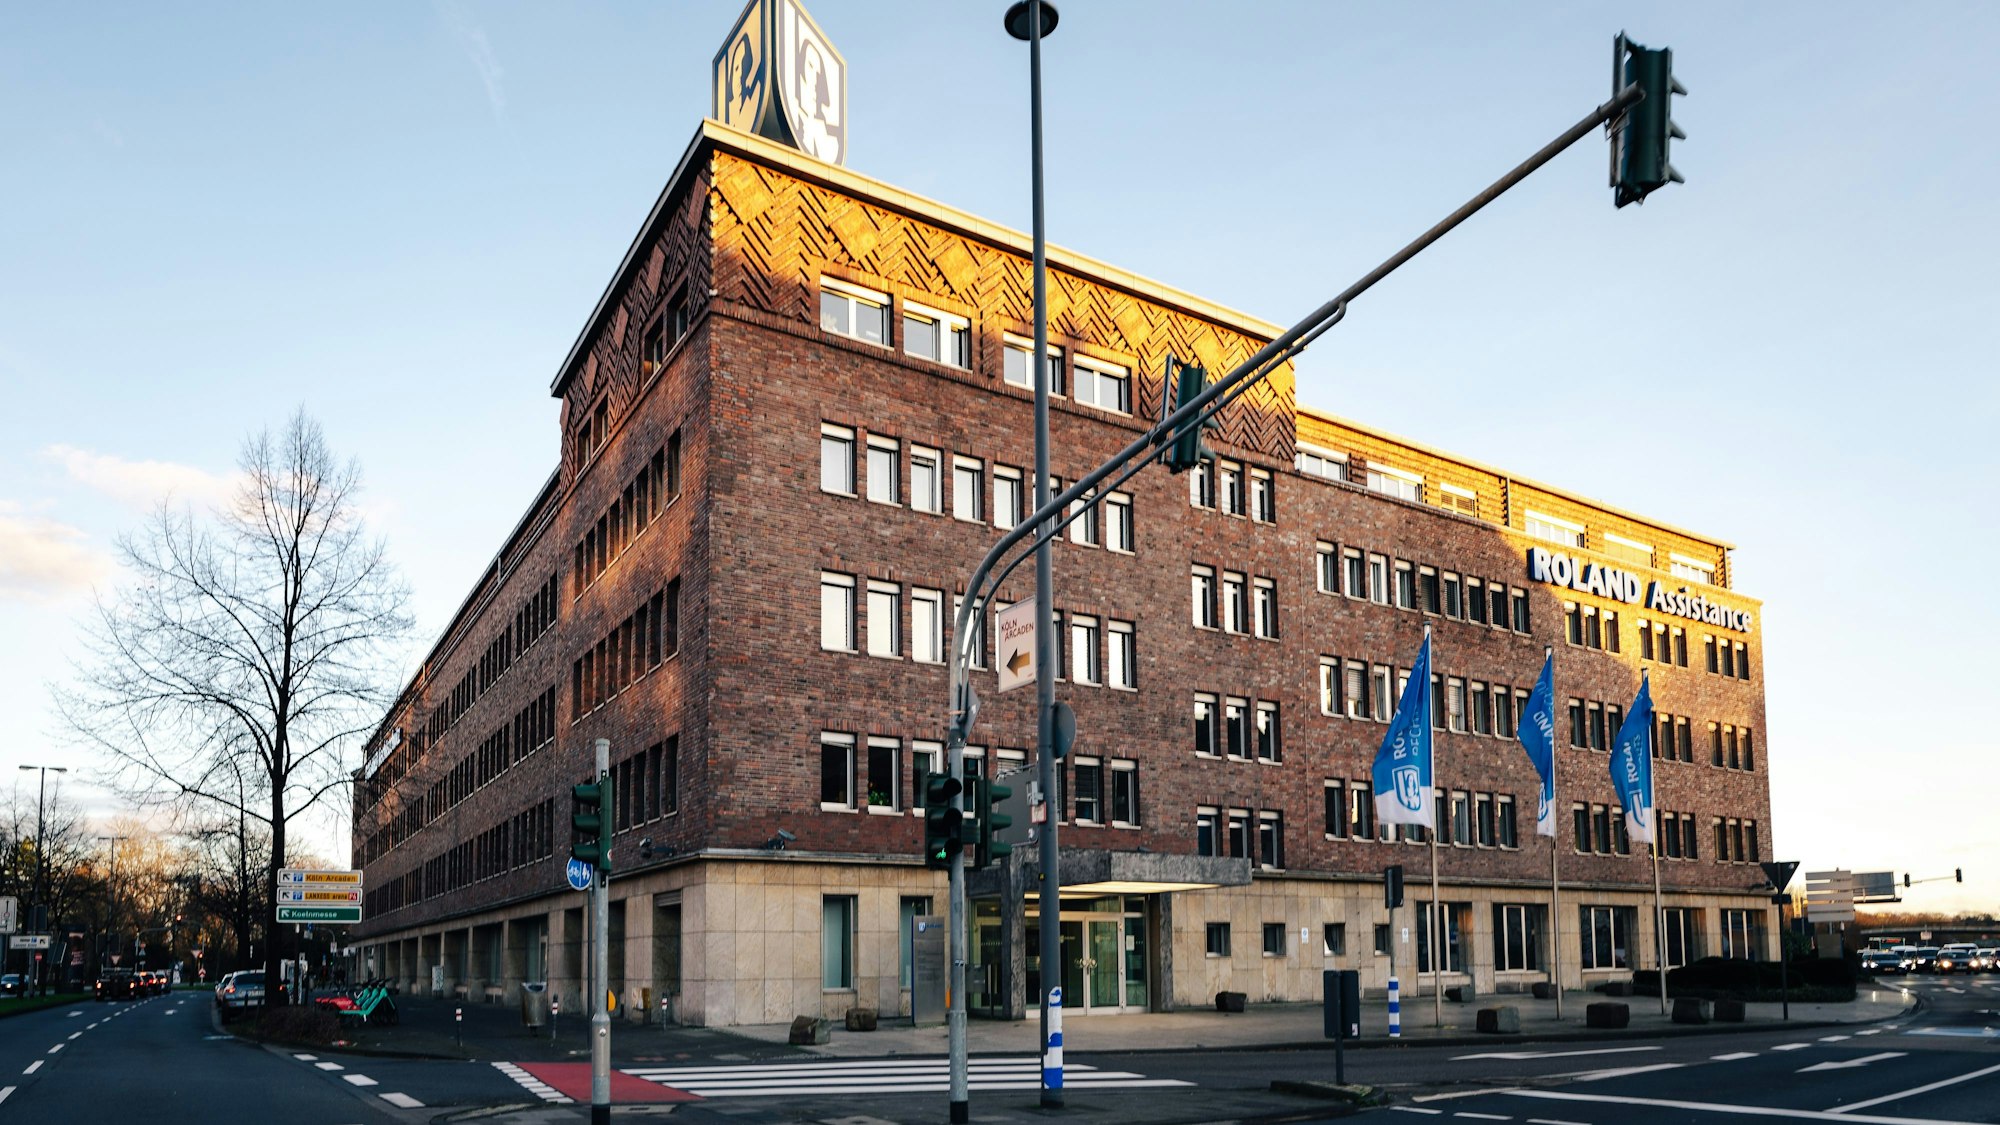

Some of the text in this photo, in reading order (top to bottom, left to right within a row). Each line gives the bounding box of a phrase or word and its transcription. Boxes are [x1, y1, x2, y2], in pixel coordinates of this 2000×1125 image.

[1529, 547, 1753, 633] ROLAND Assistance
[1001, 618, 1018, 631] KÖLN
[1004, 622, 1034, 642] ARCADEN
[305, 892, 330, 900] LANXESS
[291, 910, 338, 918] Koelnmesse
